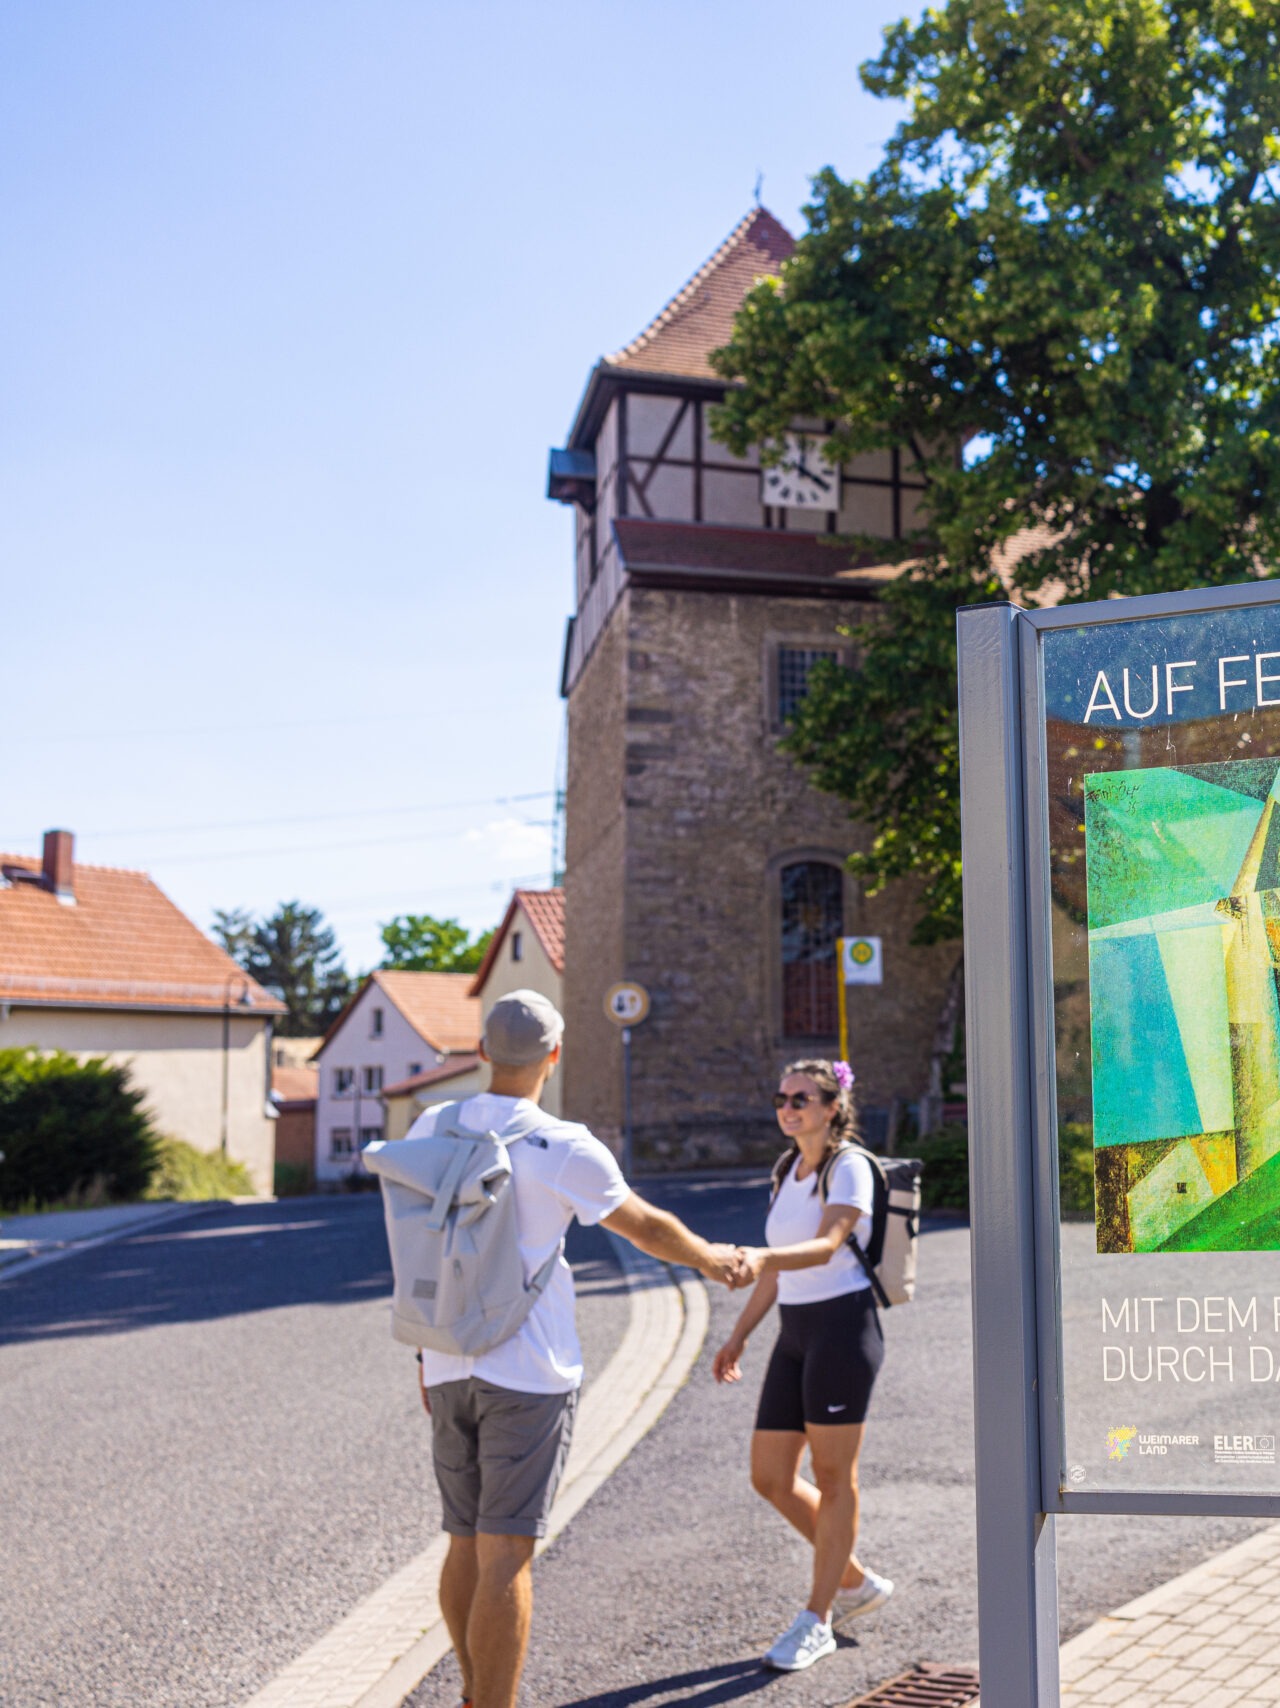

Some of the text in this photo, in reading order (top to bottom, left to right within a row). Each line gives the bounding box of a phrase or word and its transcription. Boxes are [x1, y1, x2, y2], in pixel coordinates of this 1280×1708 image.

[1083, 660, 1197, 723] AUF
[1101, 1297, 1163, 1333] MIT
[1176, 1296, 1258, 1333] DEM
[1102, 1345, 1234, 1382] DURCH
[1138, 1435, 1199, 1445] WEIMARER
[1138, 1445, 1168, 1455] LAND
[1213, 1435, 1254, 1451] ELER
